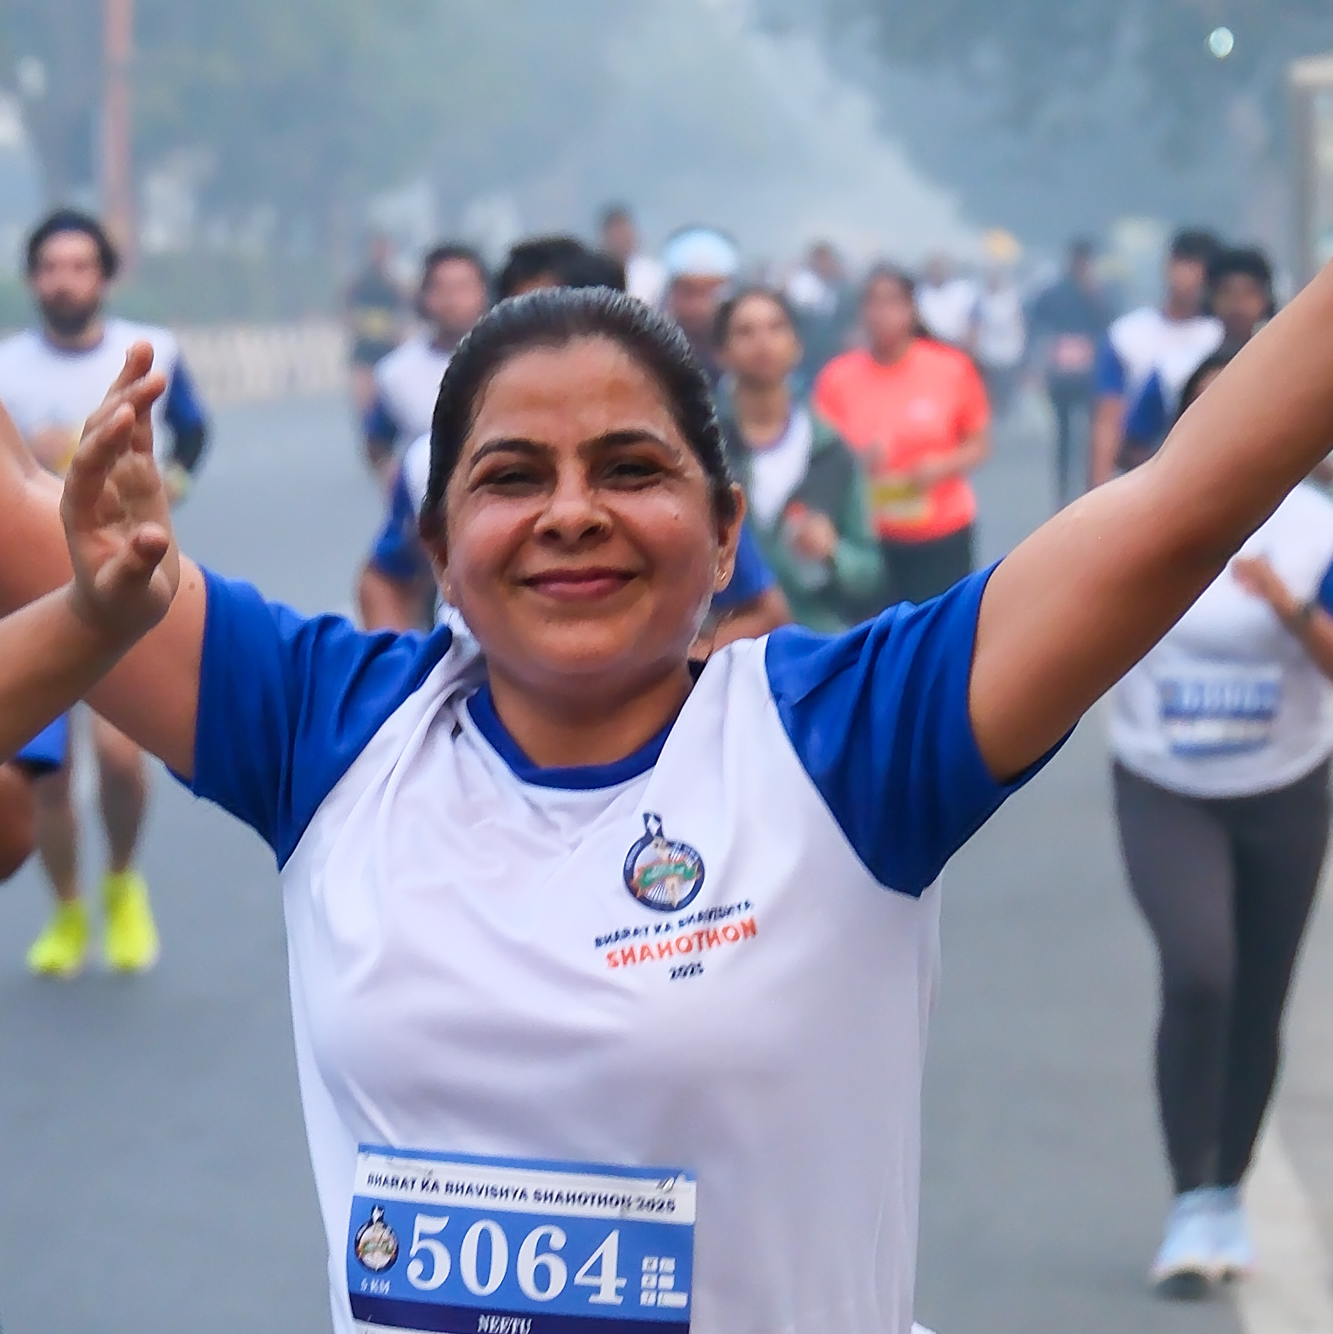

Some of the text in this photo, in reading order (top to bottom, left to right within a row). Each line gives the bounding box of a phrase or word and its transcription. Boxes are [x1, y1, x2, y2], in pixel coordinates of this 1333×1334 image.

[606, 917, 757, 968] SHAHOTHON
[367, 1172, 417, 1192] BHARAT
[420, 1178, 440, 1194] KA
[444, 1181, 528, 1203] BHAVISHYA
[533, 1188, 632, 1211] SHAHOTHON
[406, 1213, 627, 1306] 5064
